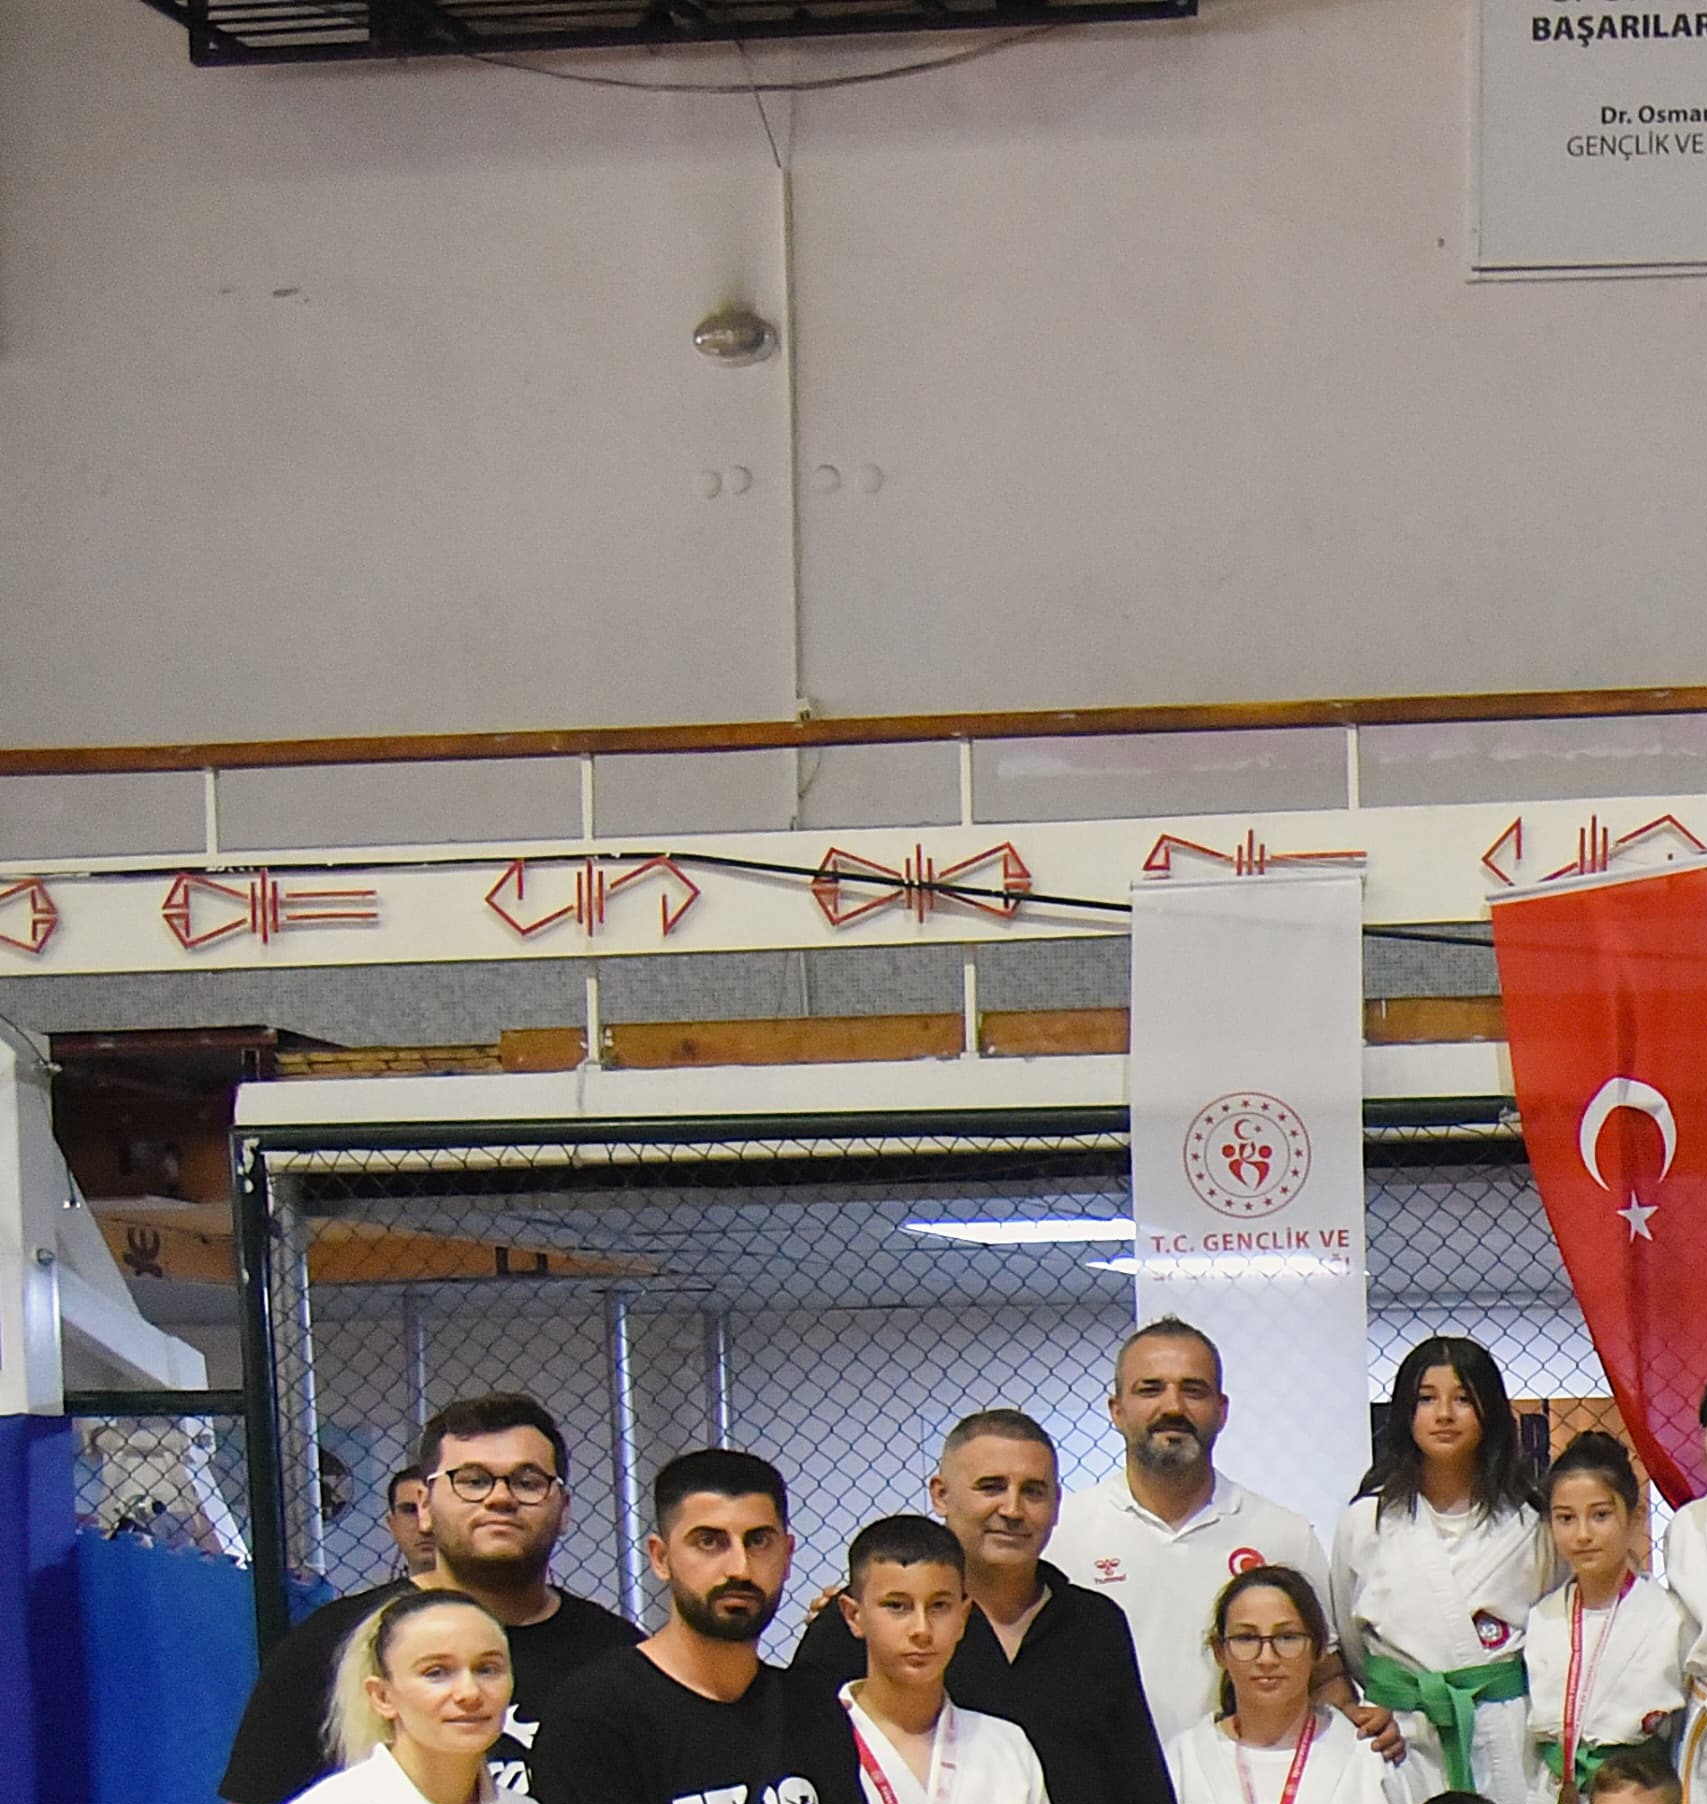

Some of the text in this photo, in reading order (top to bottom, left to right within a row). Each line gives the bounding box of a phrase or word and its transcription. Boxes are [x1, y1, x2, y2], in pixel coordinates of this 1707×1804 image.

[1601, 106, 1632, 125] Dr.
[1567, 130, 1669, 161] GENÇLİK
[1675, 134, 1704, 154] VE
[1151, 1227, 1350, 1255] T.C. GENÇLİK VE
